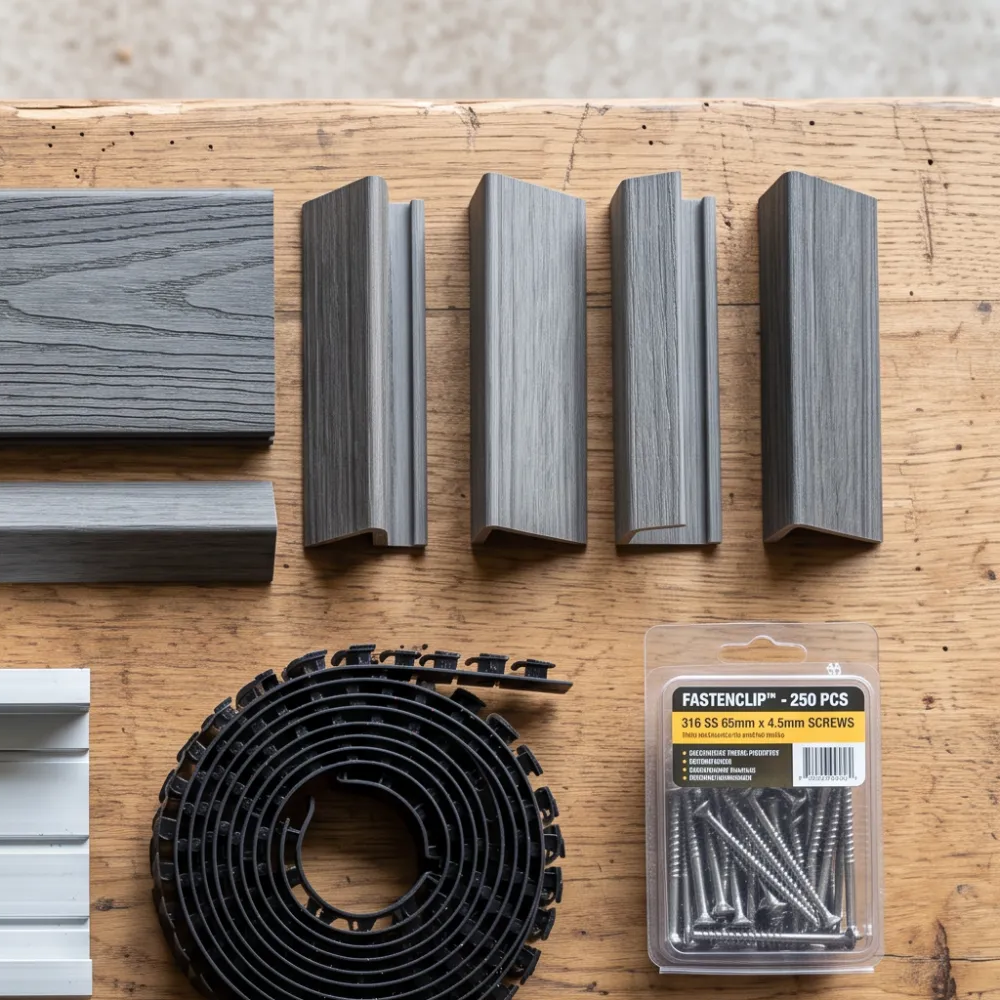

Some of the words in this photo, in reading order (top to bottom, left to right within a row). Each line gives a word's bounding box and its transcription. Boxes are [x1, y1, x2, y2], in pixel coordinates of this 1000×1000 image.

[790, 692, 817, 707] 250
[820, 692, 849, 707] PCS
[682, 717, 702, 729] 316
[704, 717, 719, 729] SS
[721, 717, 755, 729] 65mm
[758, 719, 765, 729] x
[767, 717, 805, 729] 4.5mm
[808, 717, 855, 729] SCREWS
